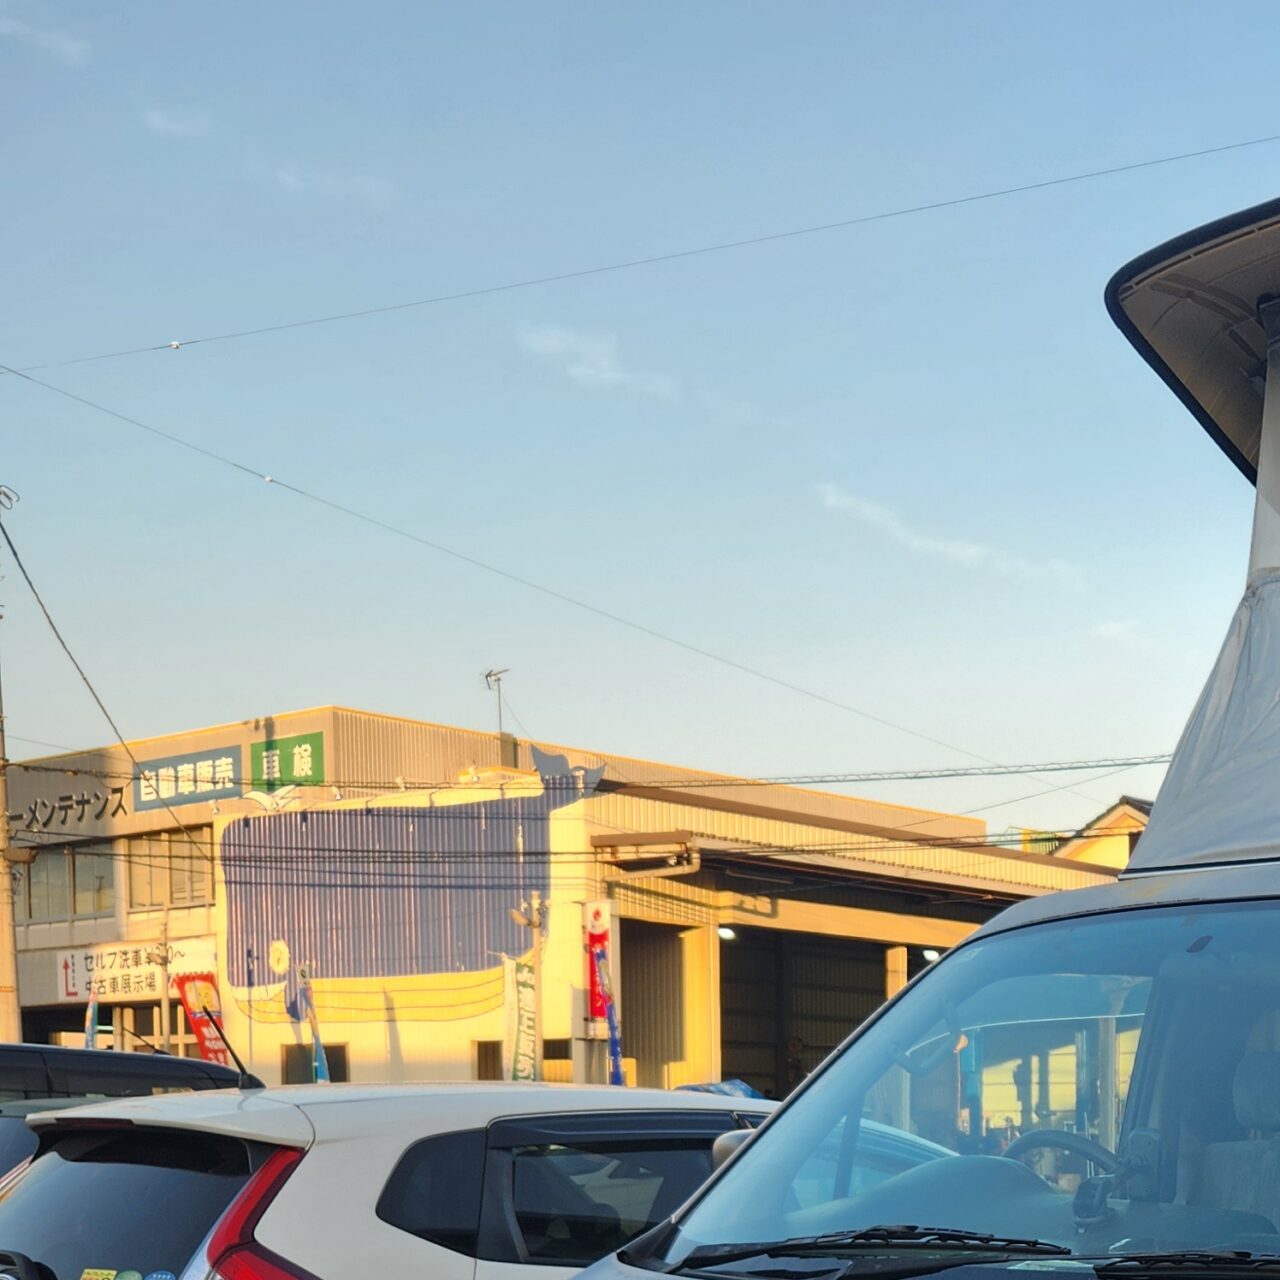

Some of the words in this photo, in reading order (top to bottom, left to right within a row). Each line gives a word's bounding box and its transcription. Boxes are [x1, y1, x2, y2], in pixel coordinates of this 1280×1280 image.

[140, 757, 234, 801] 自動車販売
[262, 744, 312, 780] 車検
